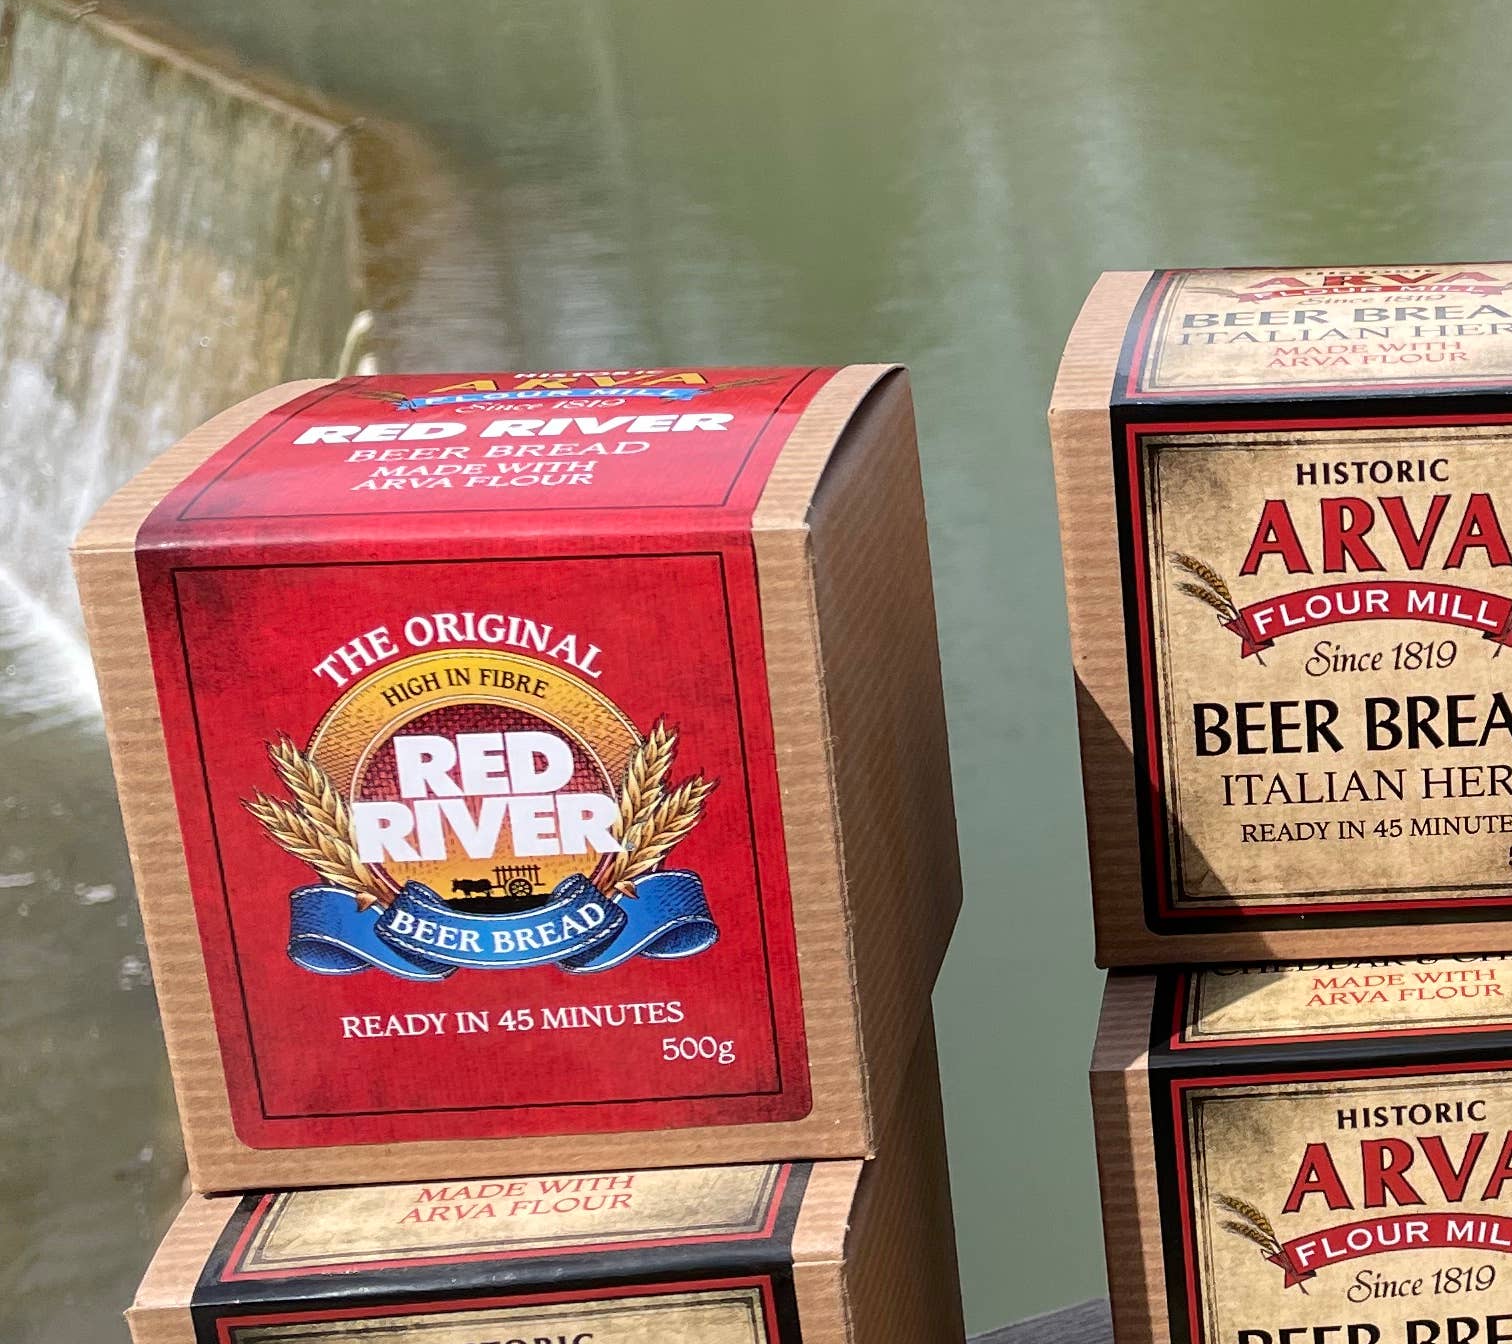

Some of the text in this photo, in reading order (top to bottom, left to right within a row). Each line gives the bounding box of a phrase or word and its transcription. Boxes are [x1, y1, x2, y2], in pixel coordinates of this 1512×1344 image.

[1247, 271, 1500, 289] ARVA
[1182, 309, 1330, 329] BEER
[1178, 326, 1390, 346] ITALIAN
[1274, 341, 1462, 355] MADE WITH
[1266, 351, 1468, 369] ARVA FLOUR
[424, 388, 682, 406] FLOUR MILL
[427, 372, 708, 393] ARVA
[293, 413, 734, 444] RED RIVER
[344, 441, 650, 463] BEER BREAD
[349, 473, 594, 491] ARVA FLOUR
[369, 460, 597, 478] MADE WITH
[1295, 458, 1450, 486] HISTORIC
[1251, 588, 1501, 636] FLOUR MILL
[312, 612, 604, 690] THE ORIGINAL
[1304, 639, 1459, 678] Since 1819
[381, 667, 549, 708] HIGH IN FIBRE
[1192, 699, 1346, 758] BEER
[393, 731, 574, 799] RED
[1221, 768, 1404, 807] ITALIAN
[349, 795, 628, 865] RIVER
[1240, 819, 1334, 844] READY
[1337, 818, 1366, 838] IN
[1372, 817, 1405, 838] 45
[388, 901, 608, 955] BEER BREAD
[1306, 983, 1505, 1007] ARVA FLOUR
[1312, 968, 1497, 991] MADE WITH
[341, 1001, 685, 1040] READY IN 45 MINUTES
[661, 1034, 737, 1066] 500g
[1336, 1099, 1488, 1131] HISTORIC
[414, 1174, 635, 1204] MADE WITH
[397, 1193, 634, 1225] ARVA FLOUR
[1294, 1219, 1431, 1268] FLOUR
[1346, 1264, 1497, 1303] Since 1819
